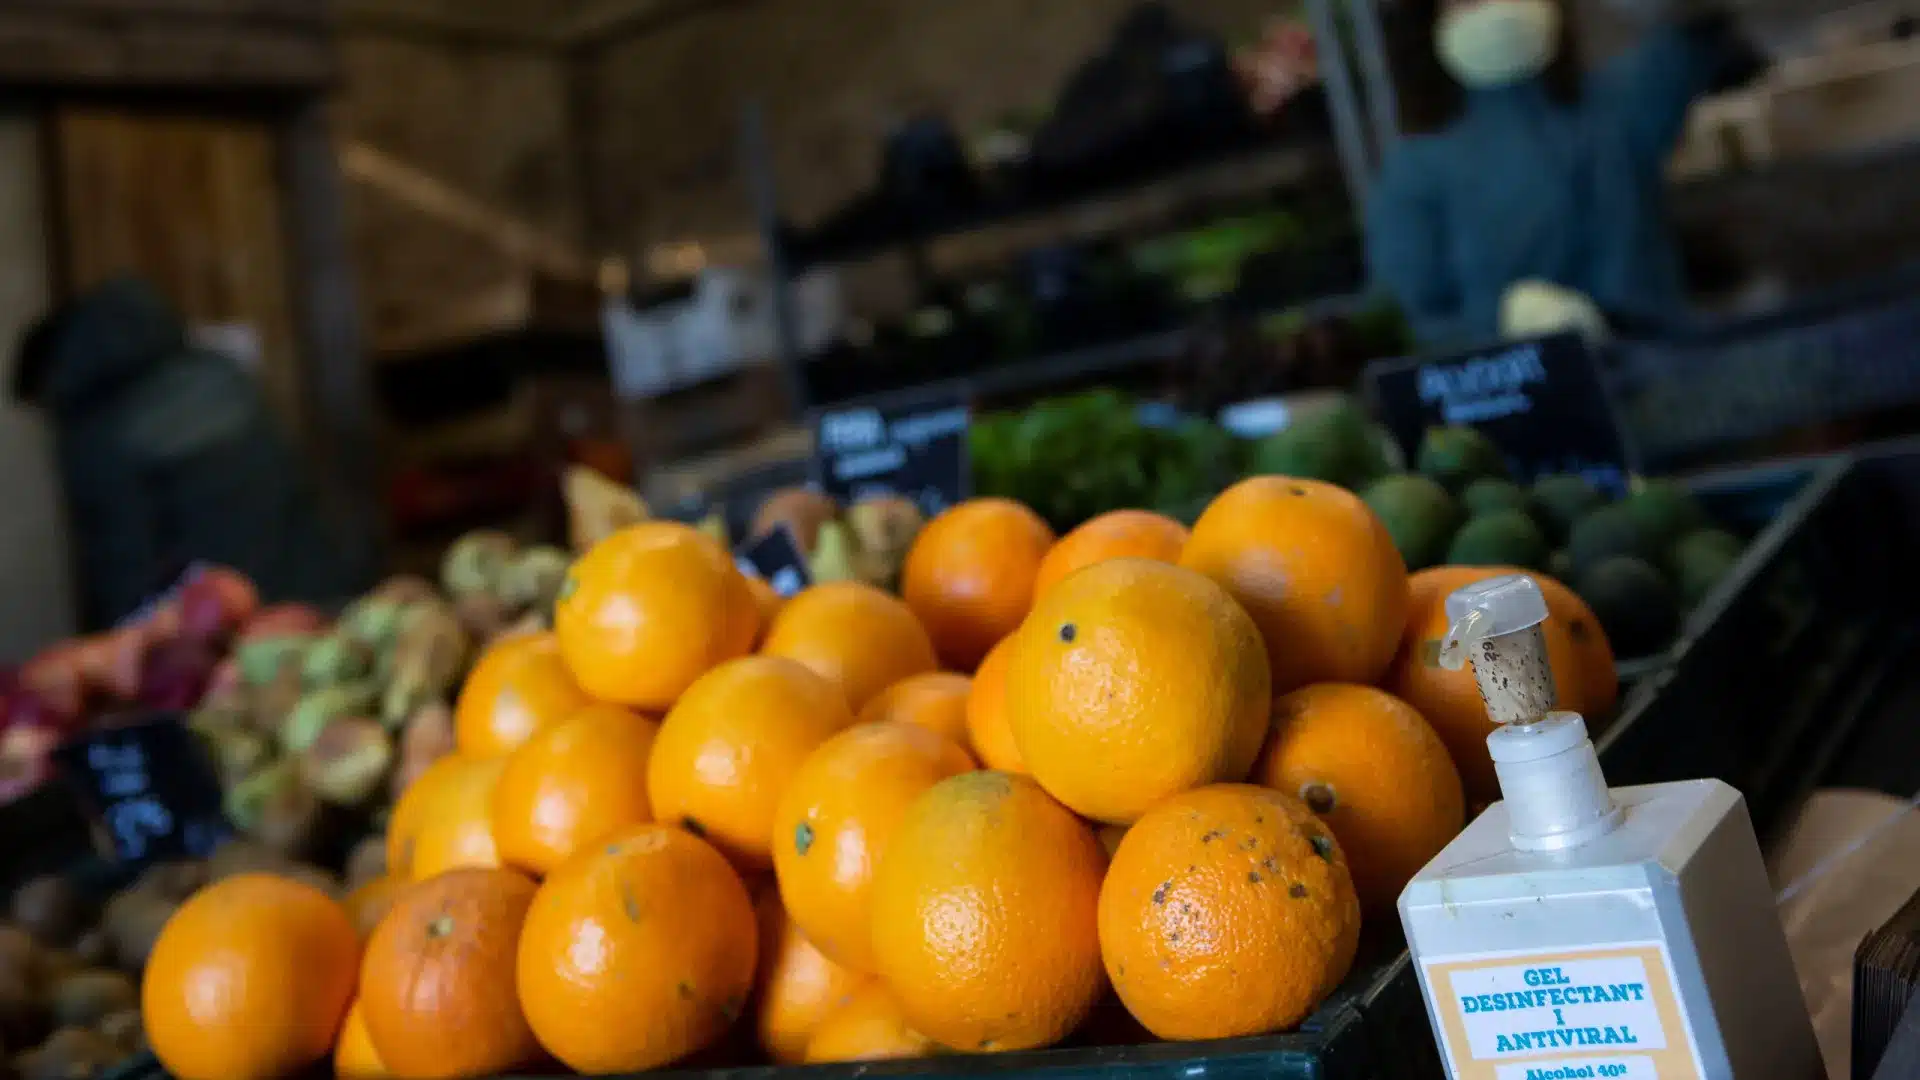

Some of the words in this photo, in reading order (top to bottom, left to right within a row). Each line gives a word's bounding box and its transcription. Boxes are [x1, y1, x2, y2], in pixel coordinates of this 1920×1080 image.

[1523, 967, 1570, 986] GEL
[1461, 983, 1644, 1013] DESINFECTANT
[1553, 1009, 1565, 1026] I
[1496, 1026, 1637, 1052] ANTIVIRAL
[1526, 1065, 1594, 1080] Alcohol
